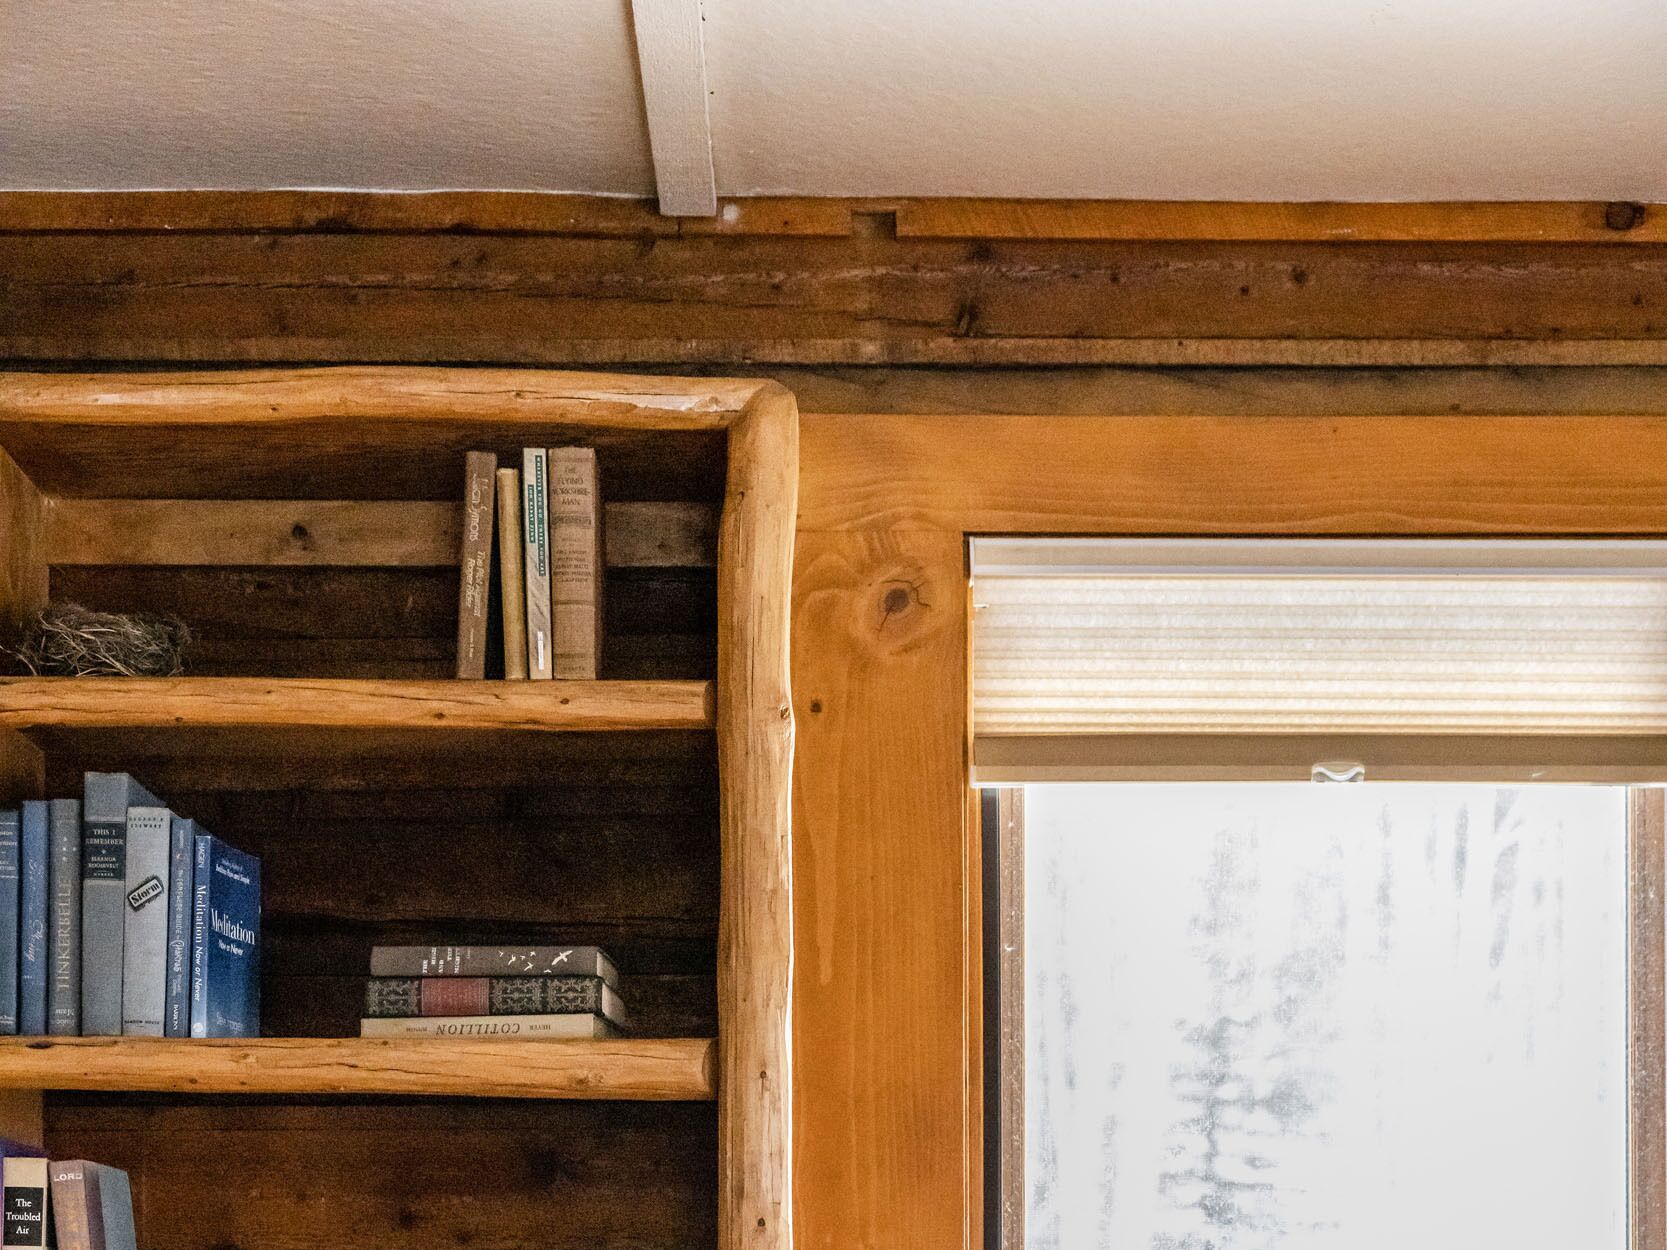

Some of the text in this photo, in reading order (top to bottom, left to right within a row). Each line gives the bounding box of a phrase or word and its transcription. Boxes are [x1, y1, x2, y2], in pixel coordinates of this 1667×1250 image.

[561, 498, 581, 506] MAN
[476, 551, 485, 566] The
[466, 558, 475, 583] Roger
[130, 883, 160, 904] Storm
[211, 908, 255, 945] Meditation
[57, 879, 72, 991] TINKERBELLE
[195, 885, 206, 1002] Meditation Now or Never
[435, 1023, 521, 1035] COTILLION
[54, 1173, 83, 1182] LORD
[15, 1199, 32, 1207] The
[5, 1212, 41, 1221] Troubled
[16, 1226, 29, 1234] Air
